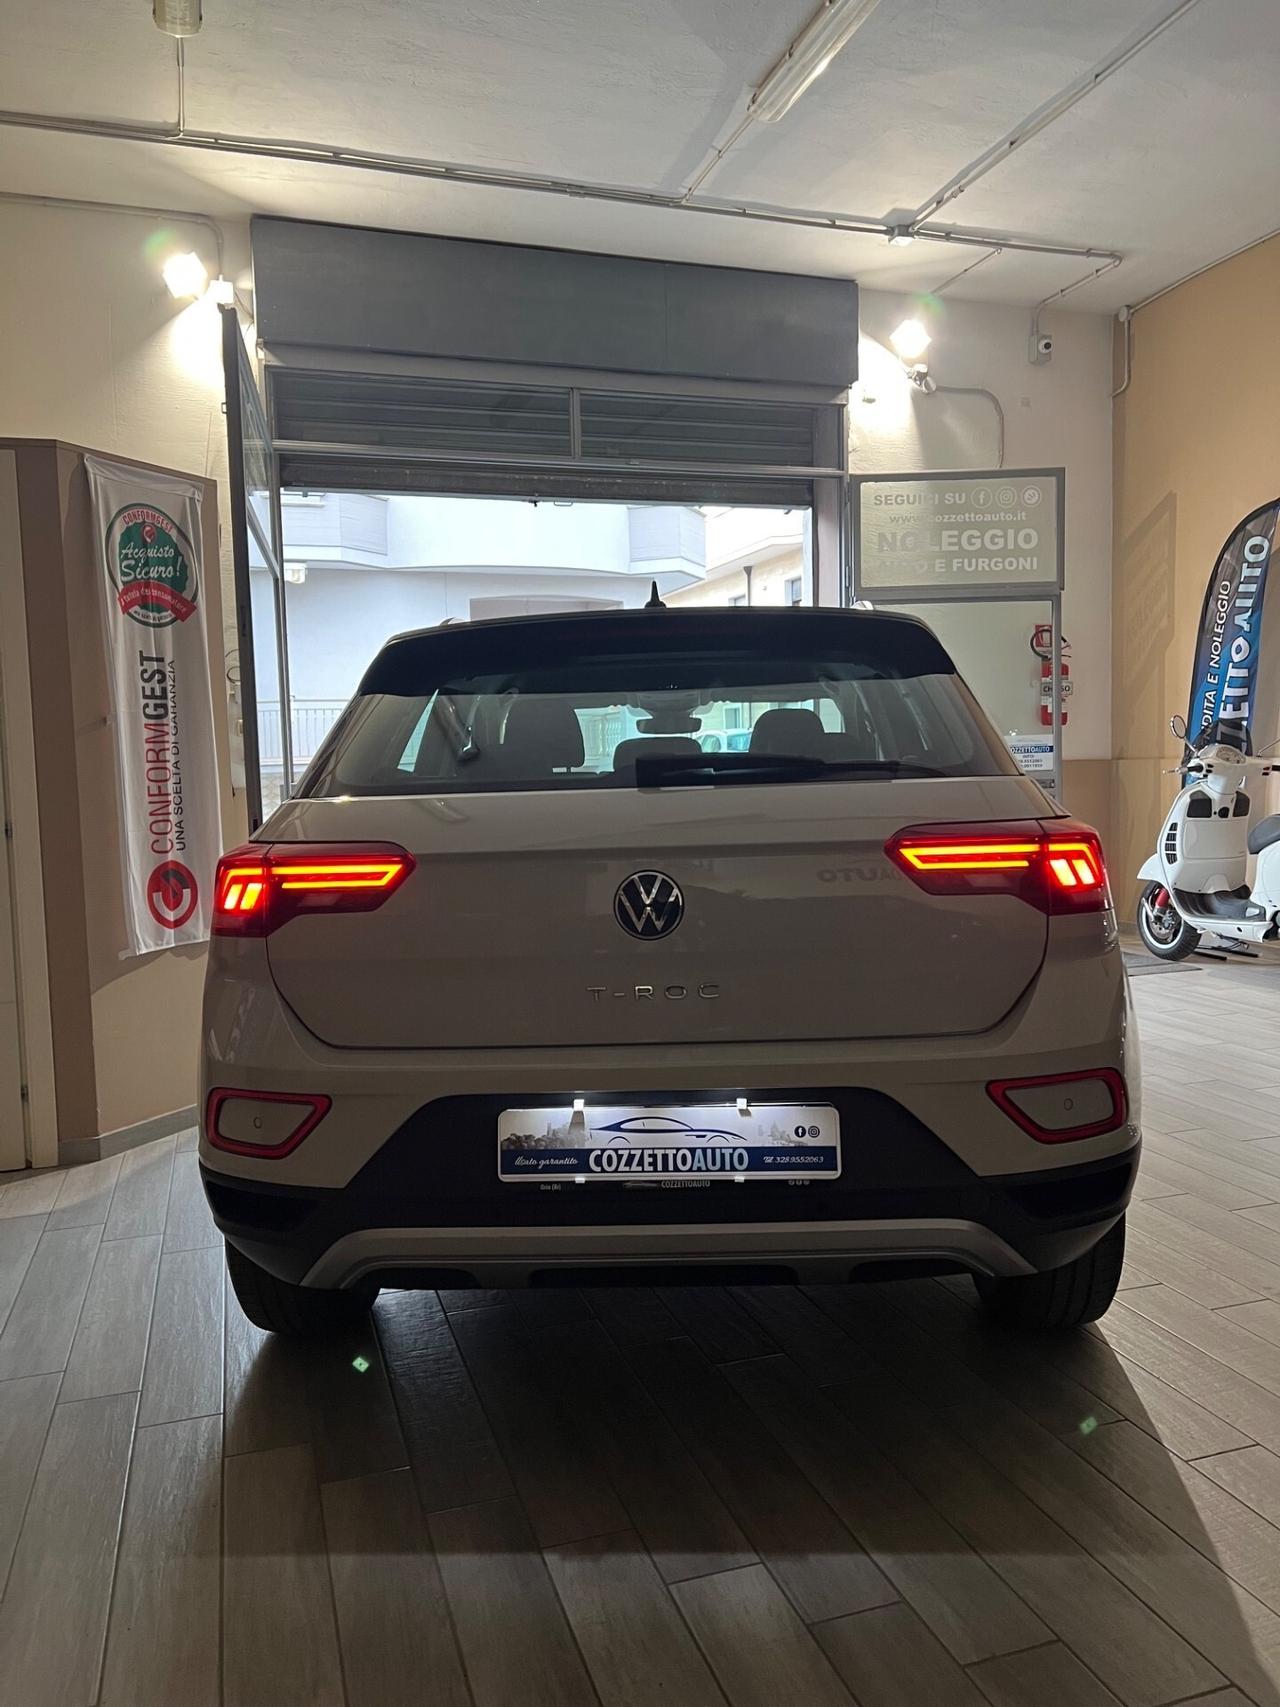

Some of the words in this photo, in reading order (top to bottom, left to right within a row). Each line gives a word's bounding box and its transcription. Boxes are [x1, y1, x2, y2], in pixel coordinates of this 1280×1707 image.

[944, 492, 966, 505] SU
[120, 542, 175, 563] Acquisto
[121, 556, 183, 581] Sicuro!
[935, 558, 947, 572] E
[952, 557, 1038, 572] FURGONI
[1209, 580, 1231, 668] NOLEGGIO
[1207, 672, 1219, 684] E
[1043, 684, 1070, 695] CHSO
[139, 650, 174, 855] CONFORMGEST
[171, 741, 180, 756] DI
[171, 759, 183, 815] SCELTA
[176, 819, 186, 851] UNA
[587, 983, 719, 1001] T-ROC
[588, 1148, 749, 1173] COZZETTOAUTO
